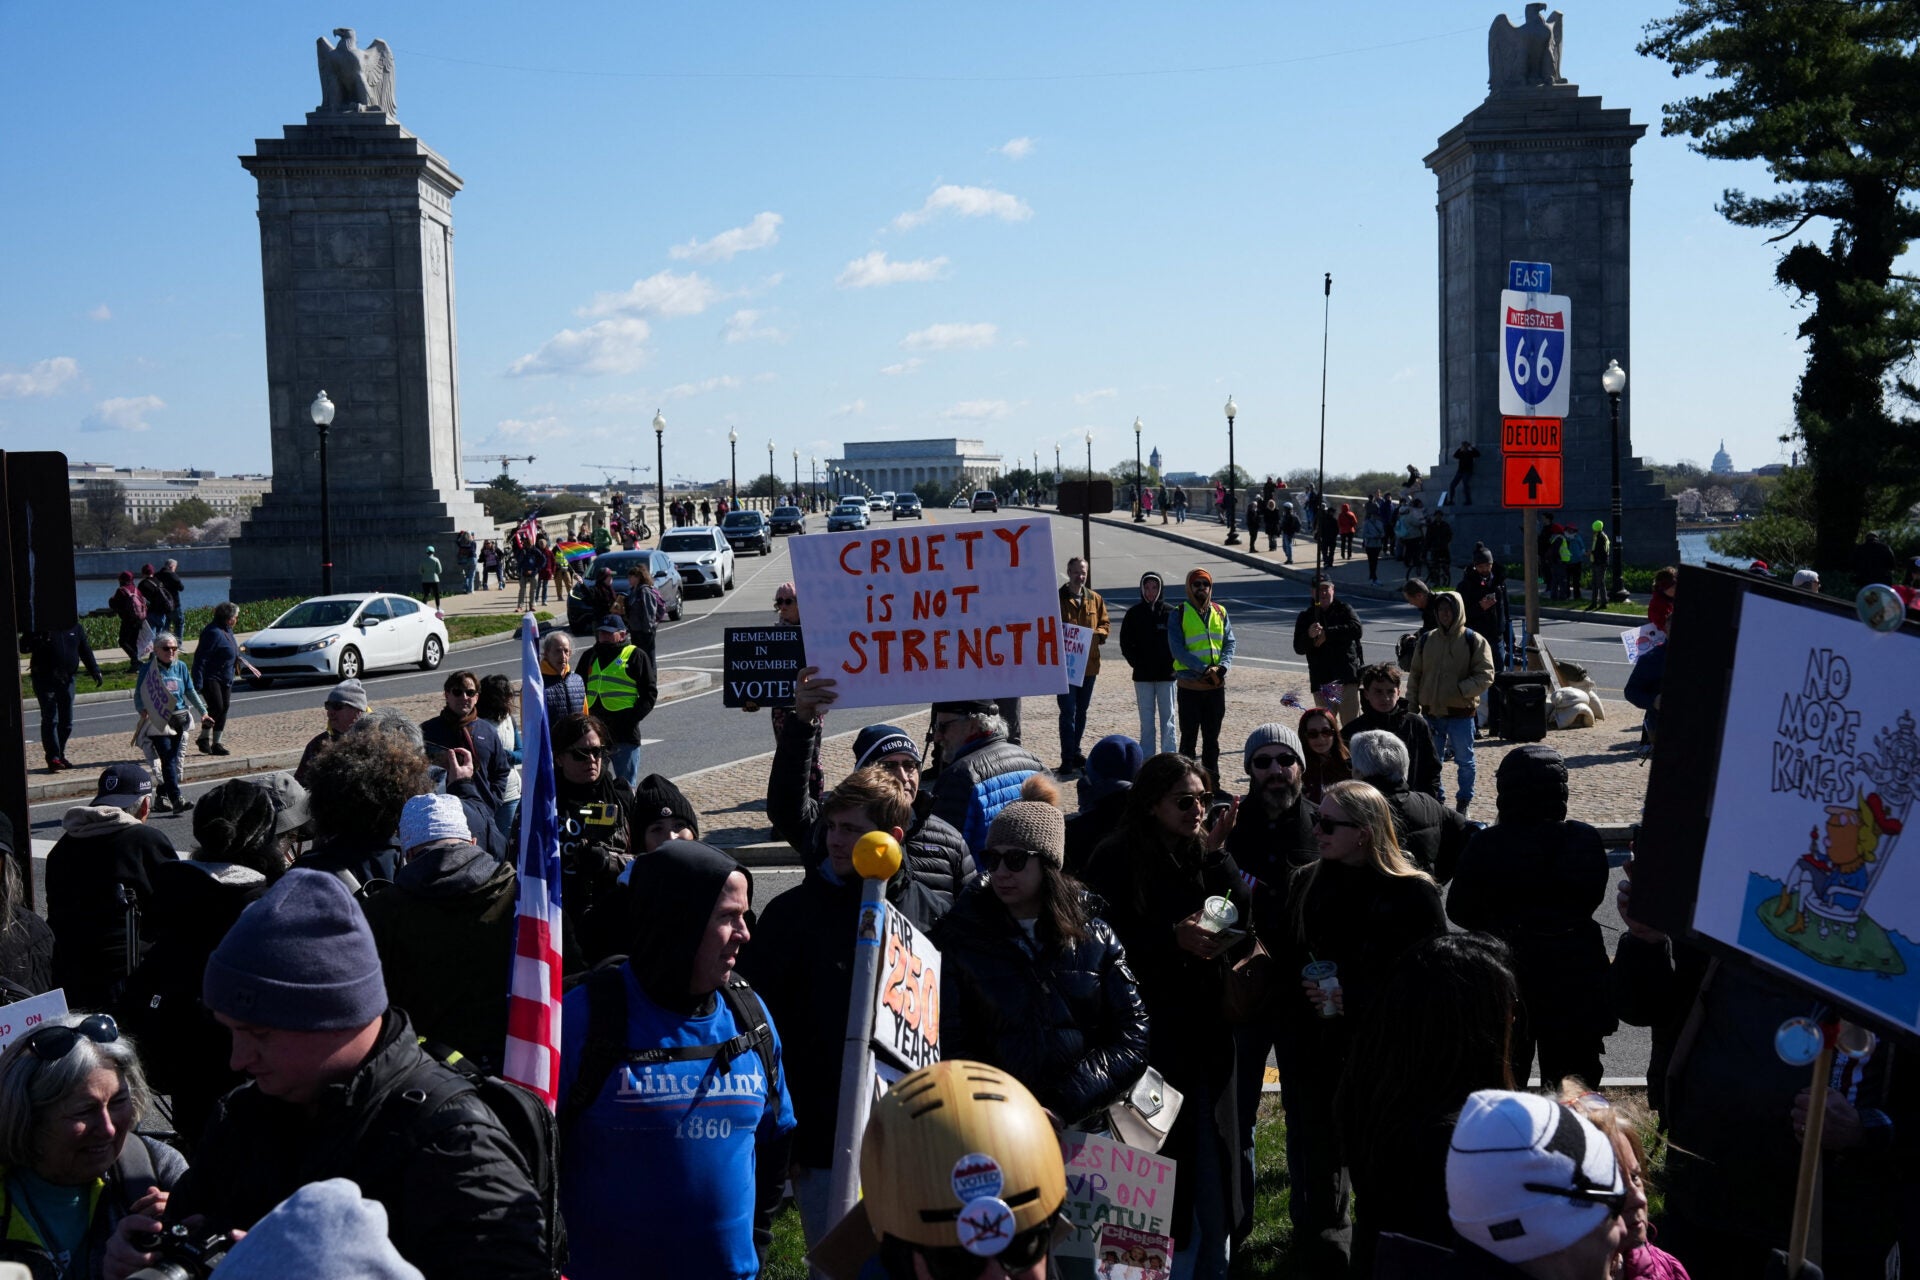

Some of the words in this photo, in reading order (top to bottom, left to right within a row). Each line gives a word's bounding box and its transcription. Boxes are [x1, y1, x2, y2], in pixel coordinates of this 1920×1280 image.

[1515, 267, 1545, 288] EAST
[1511, 312, 1556, 328] INTERSTATE
[1514, 337, 1554, 387] 66
[1506, 425, 1559, 446] DETOUR
[839, 525, 1031, 576] CRUETY
[913, 585, 979, 620] NOT
[732, 631, 798, 642] REMEMBER
[755, 646, 768, 656] IN
[841, 616, 1059, 674] STRENGTH
[731, 660, 798, 670] NOVEMBER
[1804, 648, 1851, 701] NO
[1778, 692, 1861, 758] MORE
[887, 904, 913, 956] FOR
[883, 933, 939, 1046] 250
[617, 1065, 752, 1096] Lincoln
[674, 1116, 731, 1140] 1860
[1111, 1147, 1172, 1184] NOT
[1117, 1183, 1157, 1209] ON
